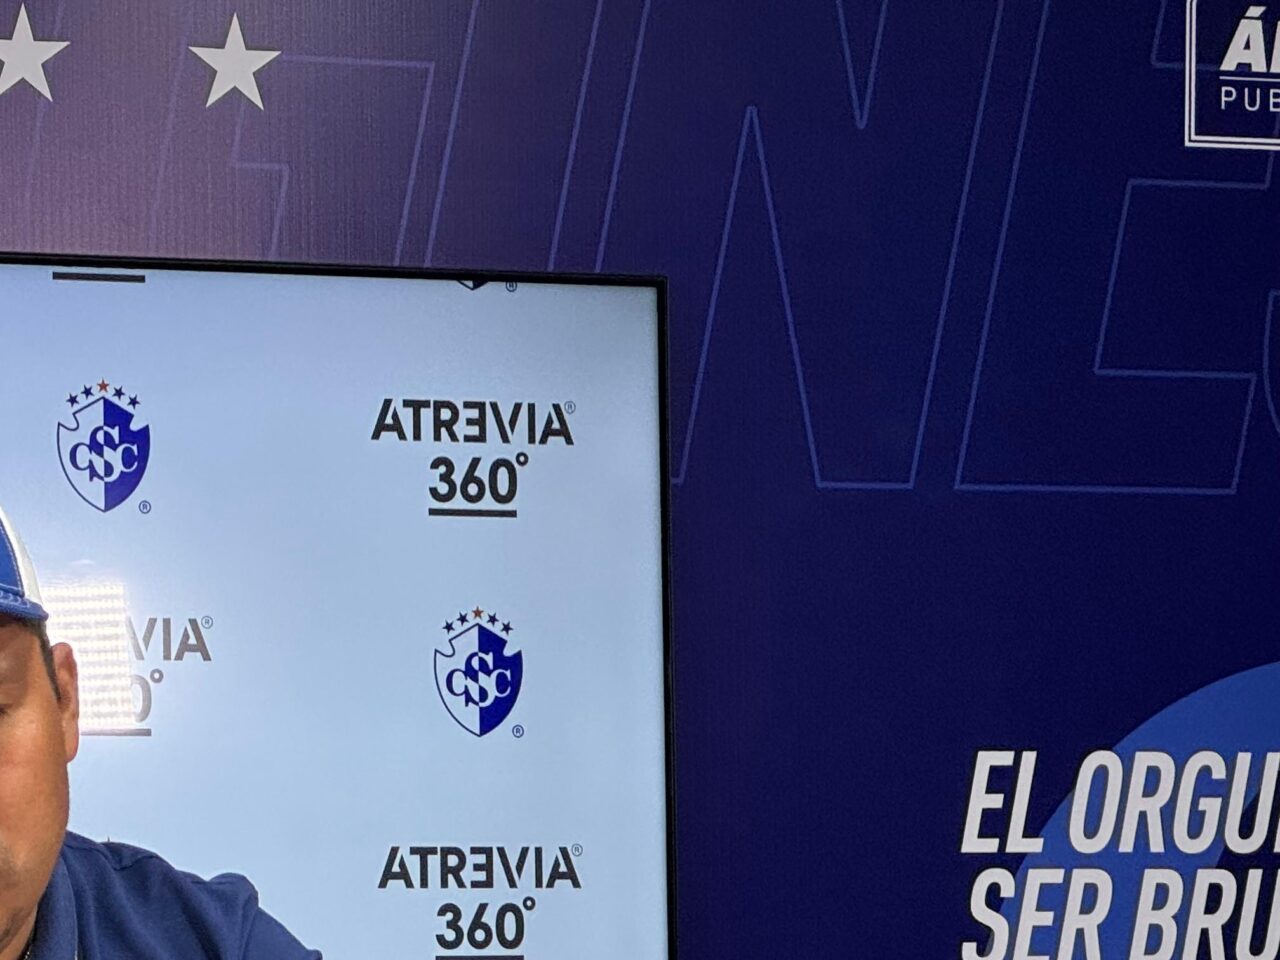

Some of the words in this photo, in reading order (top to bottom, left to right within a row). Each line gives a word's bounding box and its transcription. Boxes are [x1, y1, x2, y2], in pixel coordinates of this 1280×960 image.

[1220, 6, 1280, 73] Á
[961, 750, 1044, 853] EL
[1069, 750, 1280, 854] ORGU
